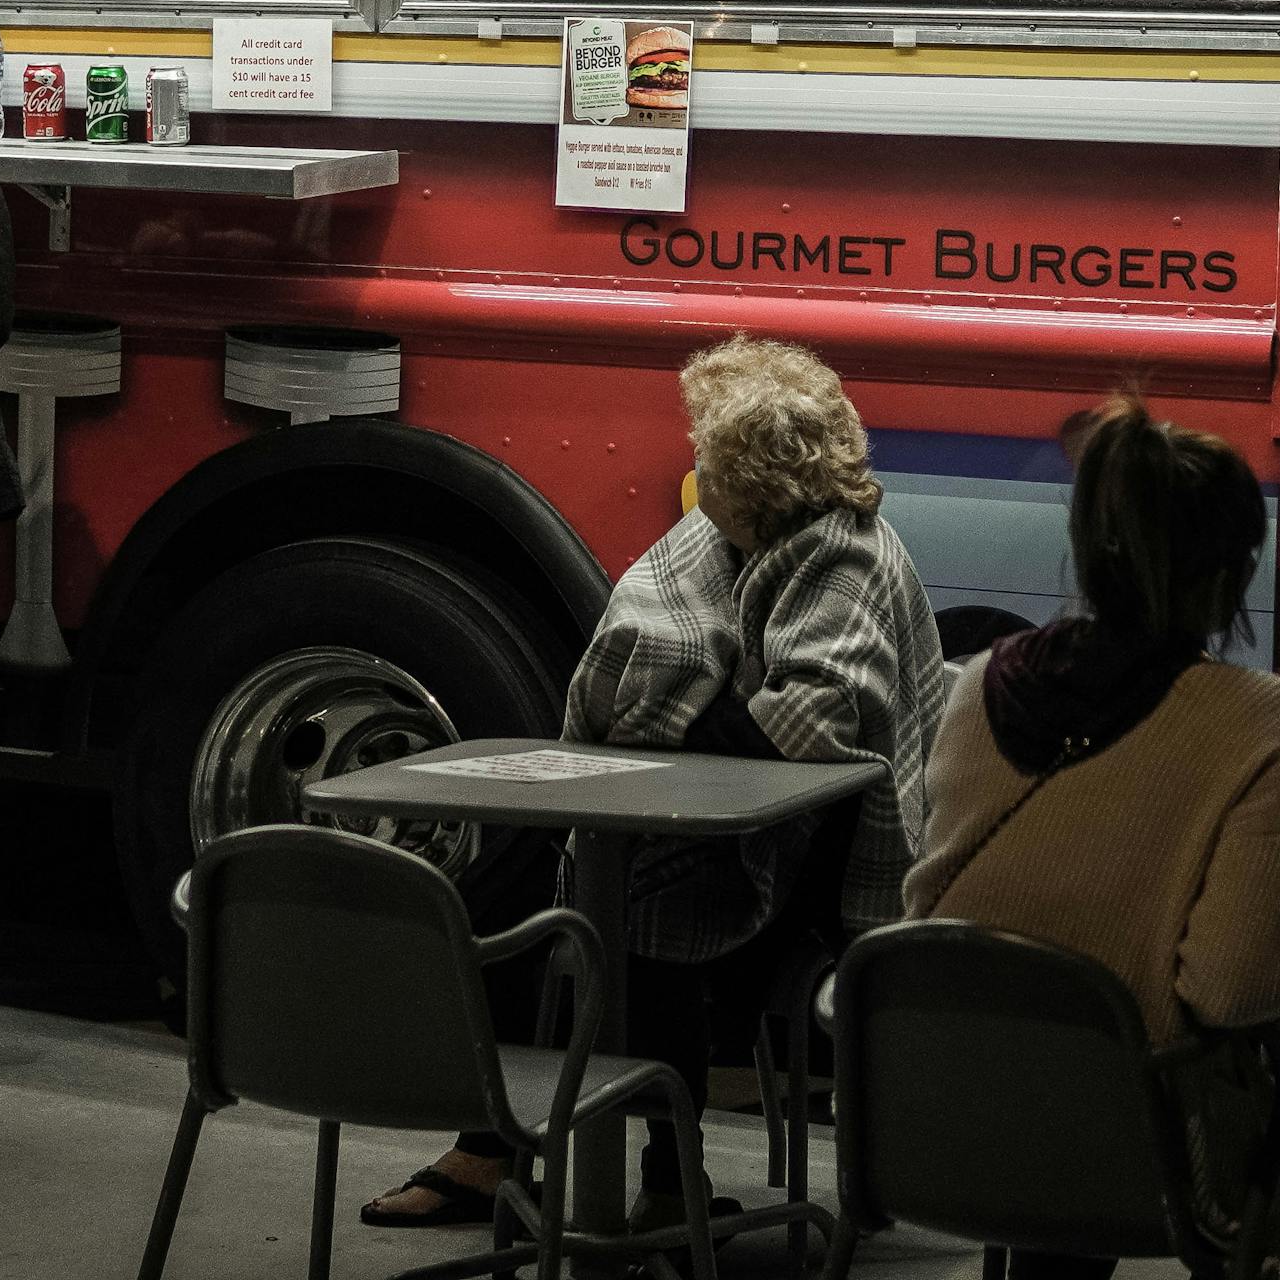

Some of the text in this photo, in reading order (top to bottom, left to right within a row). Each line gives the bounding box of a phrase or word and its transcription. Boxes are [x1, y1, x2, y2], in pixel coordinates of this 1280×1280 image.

[241, 39, 303, 49] All credit card
[575, 46, 621, 60] BEYOND
[231, 56, 313, 65] transactions under
[576, 57, 621, 70] BURGER
[233, 72, 248, 82] $10
[251, 72, 266, 82] will
[269, 73, 290, 82] have
[301, 74, 311, 82] 15
[229, 90, 314, 99] cent credit card fee
[619, 220, 1238, 293] GOURMET BURGERS
